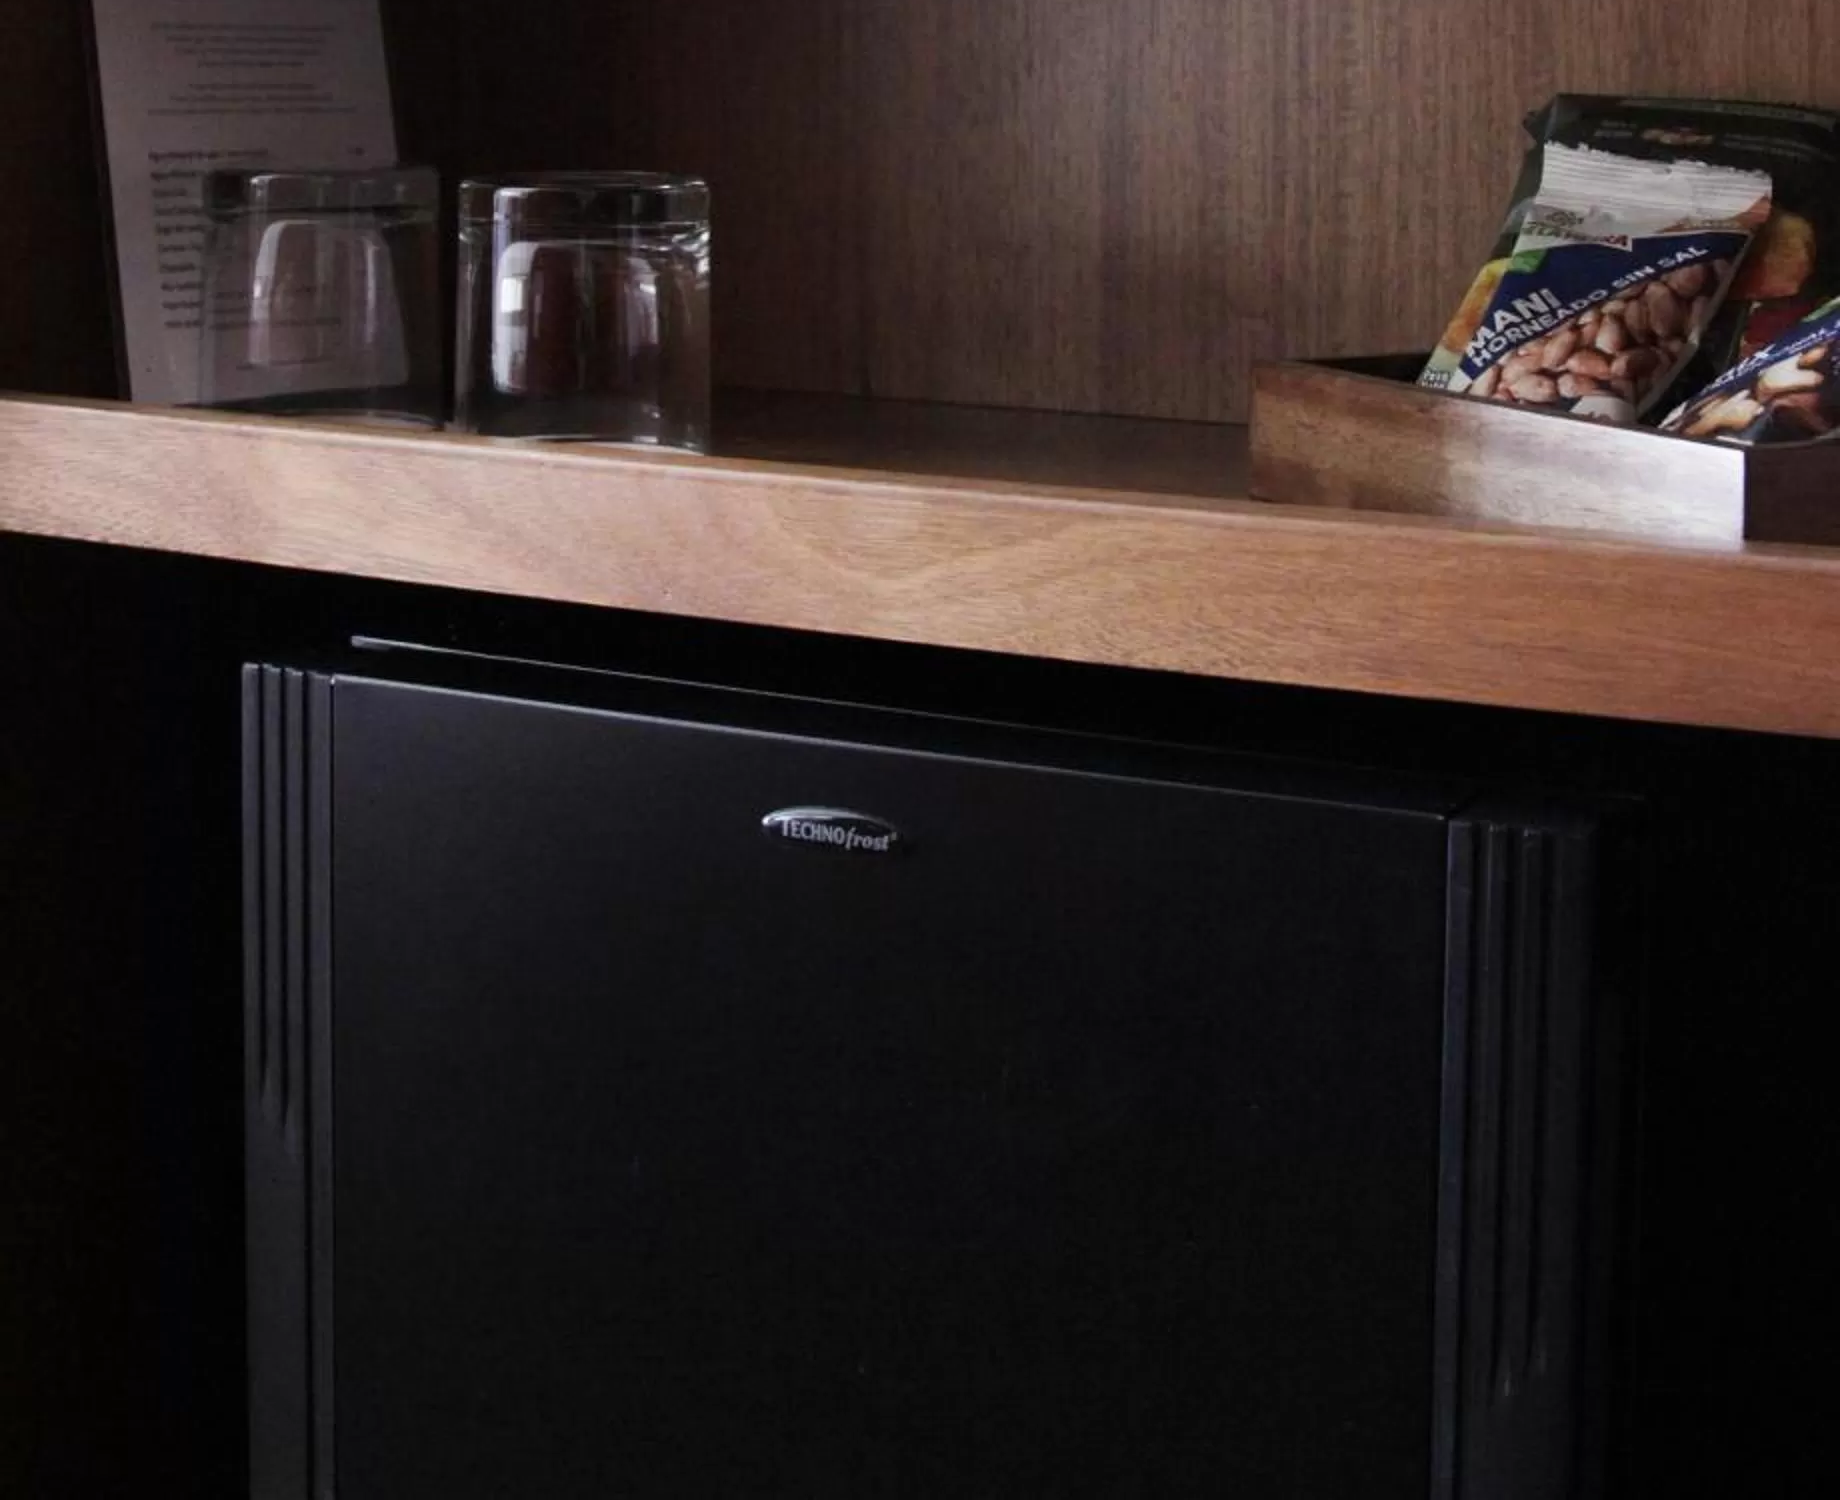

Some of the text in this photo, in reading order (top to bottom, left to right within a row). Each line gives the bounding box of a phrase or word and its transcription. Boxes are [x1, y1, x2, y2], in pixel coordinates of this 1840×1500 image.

[1466, 288, 1565, 358] MANI
[1471, 246, 1708, 368] HORNEADO SIN SAL
[780, 819, 890, 851] TECHNOfrost
